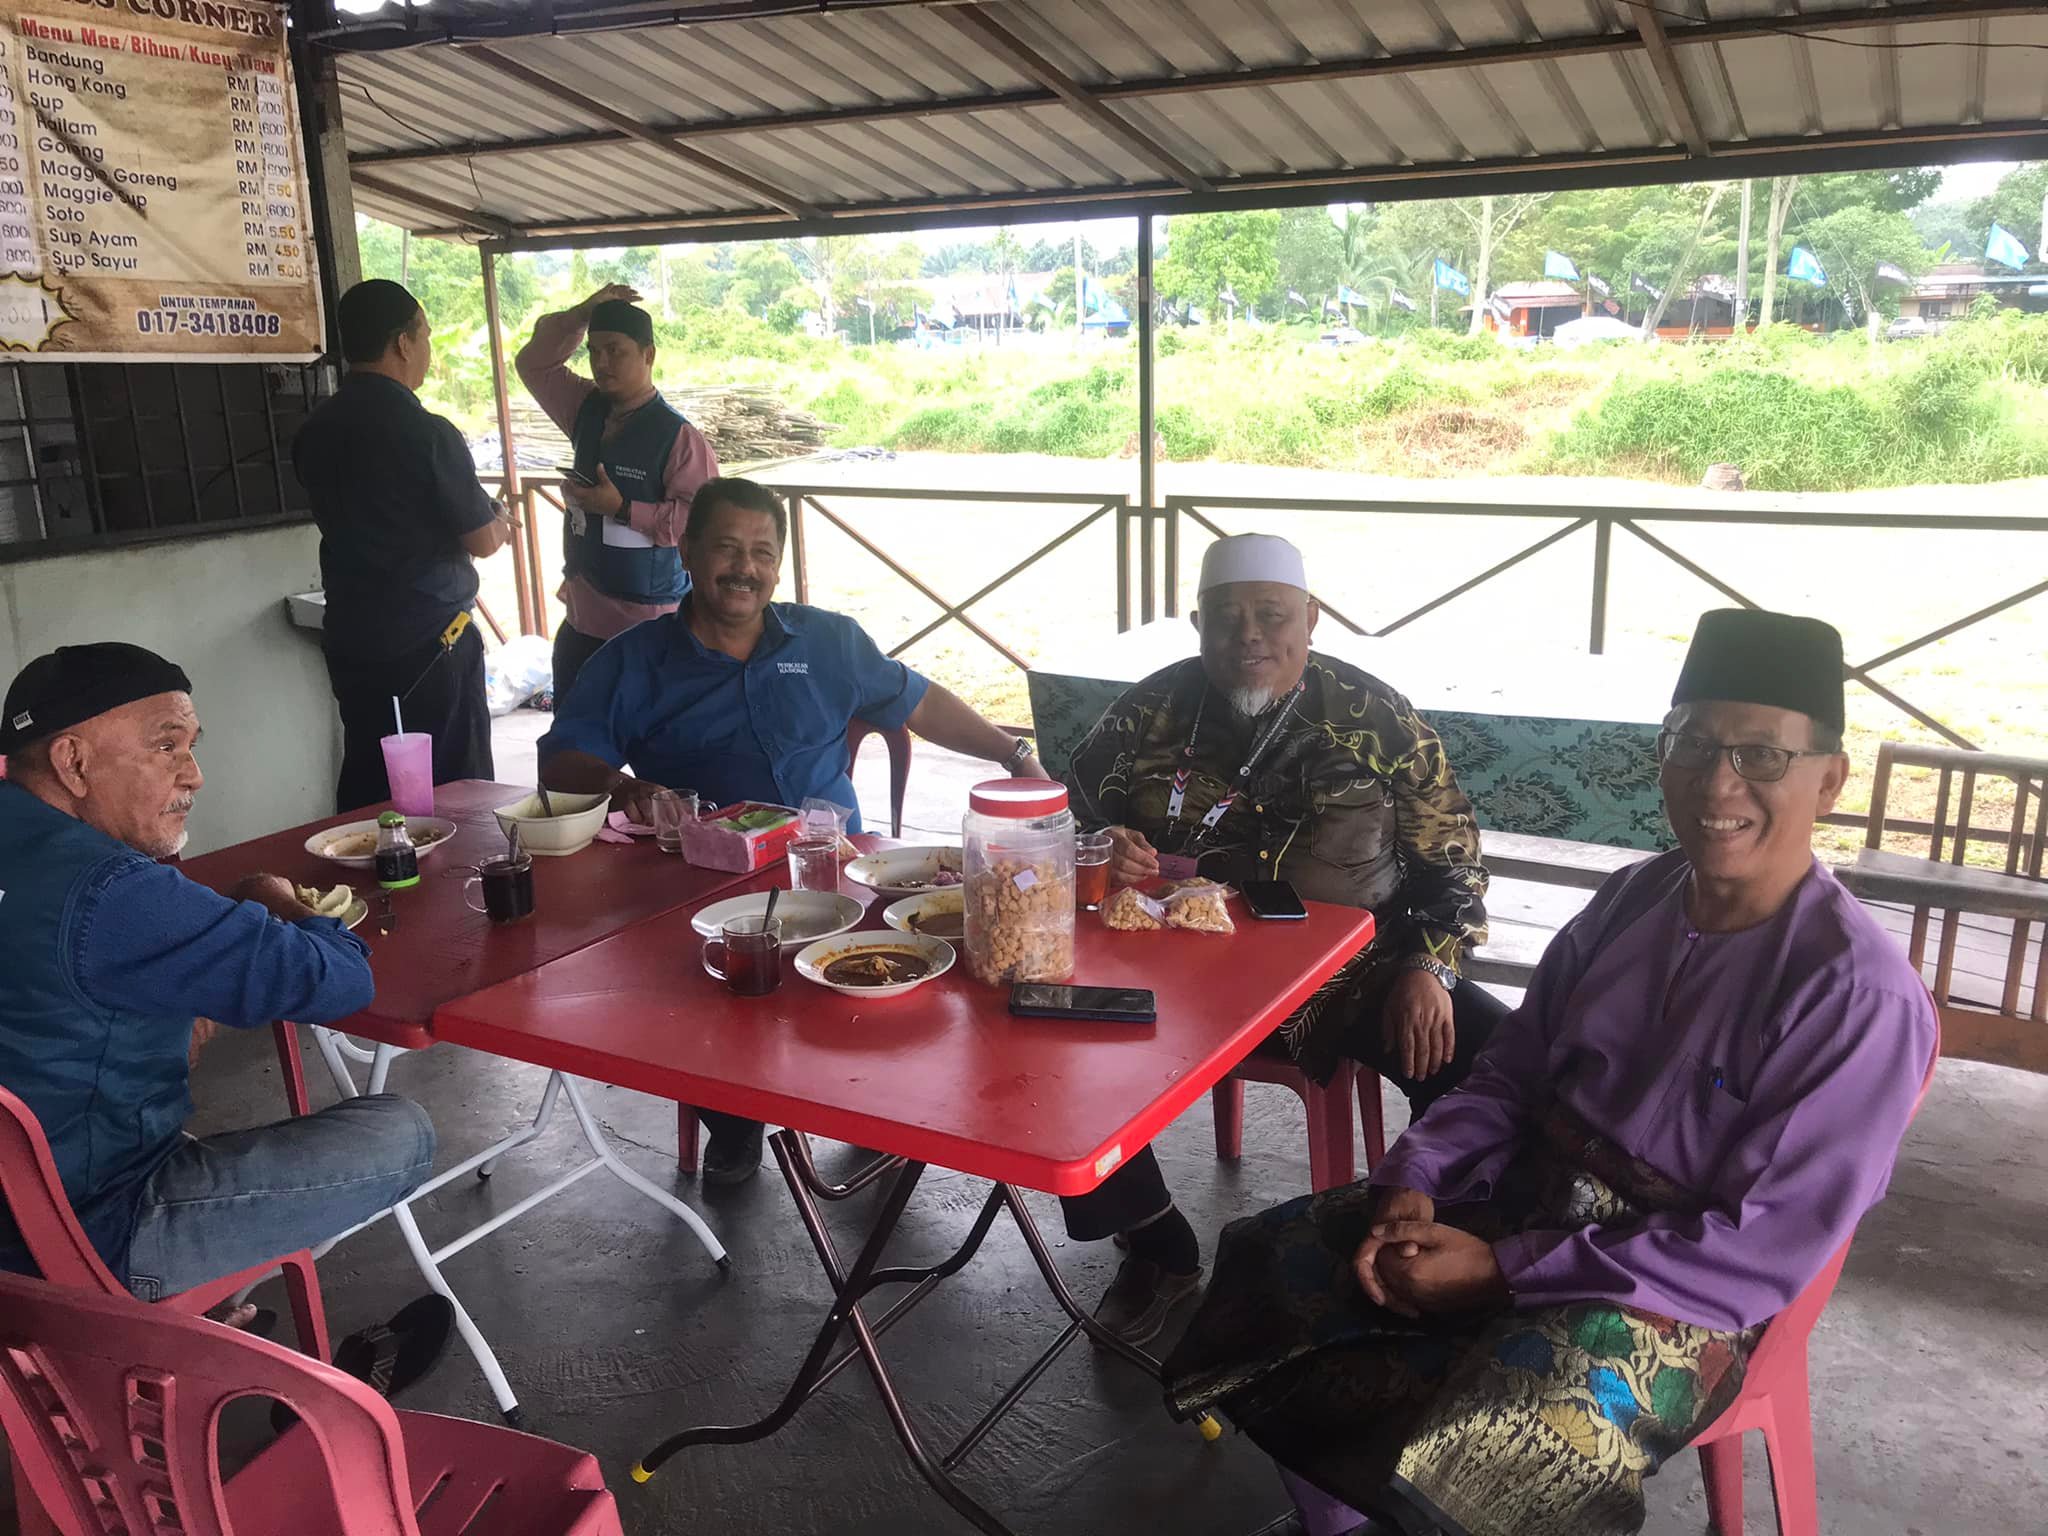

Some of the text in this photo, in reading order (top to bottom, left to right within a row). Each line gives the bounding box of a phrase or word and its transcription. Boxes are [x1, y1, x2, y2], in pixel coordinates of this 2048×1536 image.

[21, 18, 74, 43] Menu
[26, 45, 104, 75] Bandung
[227, 76, 249, 92] RM
[28, 68, 76, 93] Hong
[81, 76, 126, 99] Kong
[231, 97, 252, 112] RM
[30, 91, 64, 112] Sup
[232, 118, 254, 133] RM
[36, 112, 97, 136] Hailam
[235, 139, 256, 154] RM
[41, 160, 108, 182] Magge
[114, 168, 177, 191] Goreng
[239, 180, 260, 195] RM
[236, 160, 257, 175] RM
[44, 183, 113, 205] Maggie
[242, 201, 261, 216] RM
[46, 205, 85, 222] Soto
[244, 222, 264, 236] RM
[49, 228, 82, 246] Sup
[89, 230, 138, 248] Ayam
[246, 242, 267, 256] RM
[52, 250, 86, 269] Sup
[91, 252, 138, 271] Sayur
[249, 263, 270, 277] RM
[161, 296, 256, 311] UNTUK TEMPAHAN
[137, 310, 280, 335] 017-3418408
